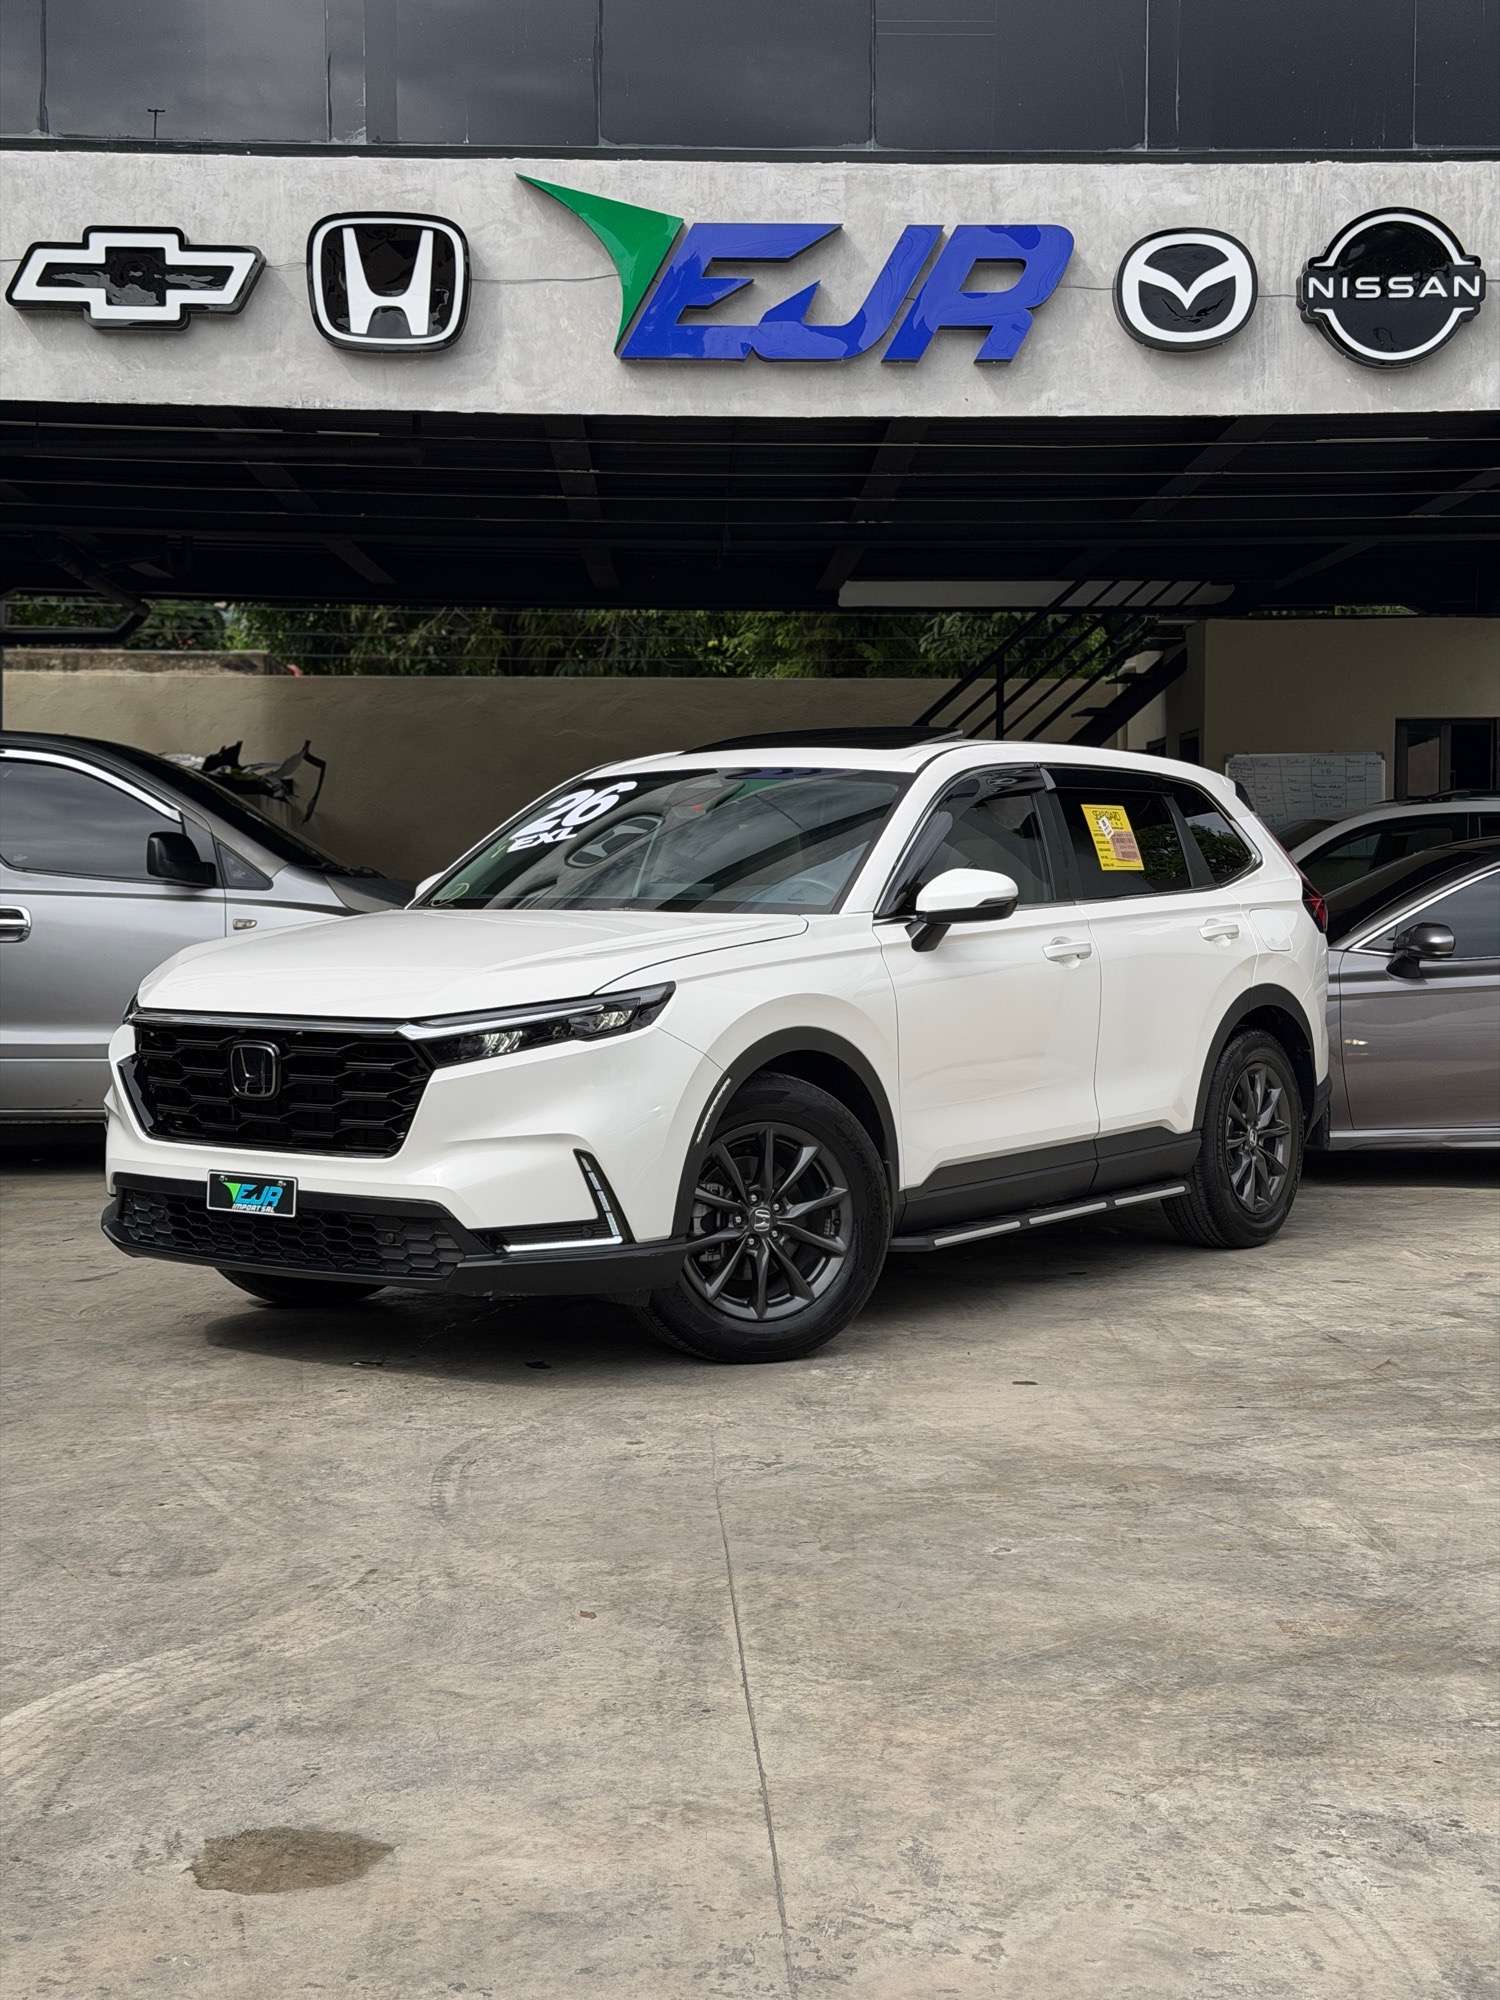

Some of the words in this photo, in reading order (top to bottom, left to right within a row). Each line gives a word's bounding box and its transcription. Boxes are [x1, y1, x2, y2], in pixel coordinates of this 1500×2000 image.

[620, 223, 1075, 362] EJR
[1308, 274, 1481, 299] NISSAN
[509, 781, 638, 840] 26
[507, 827, 577, 853] EXL
[232, 1203, 260, 1212] IMPORT
[234, 1183, 283, 1207] EJR
